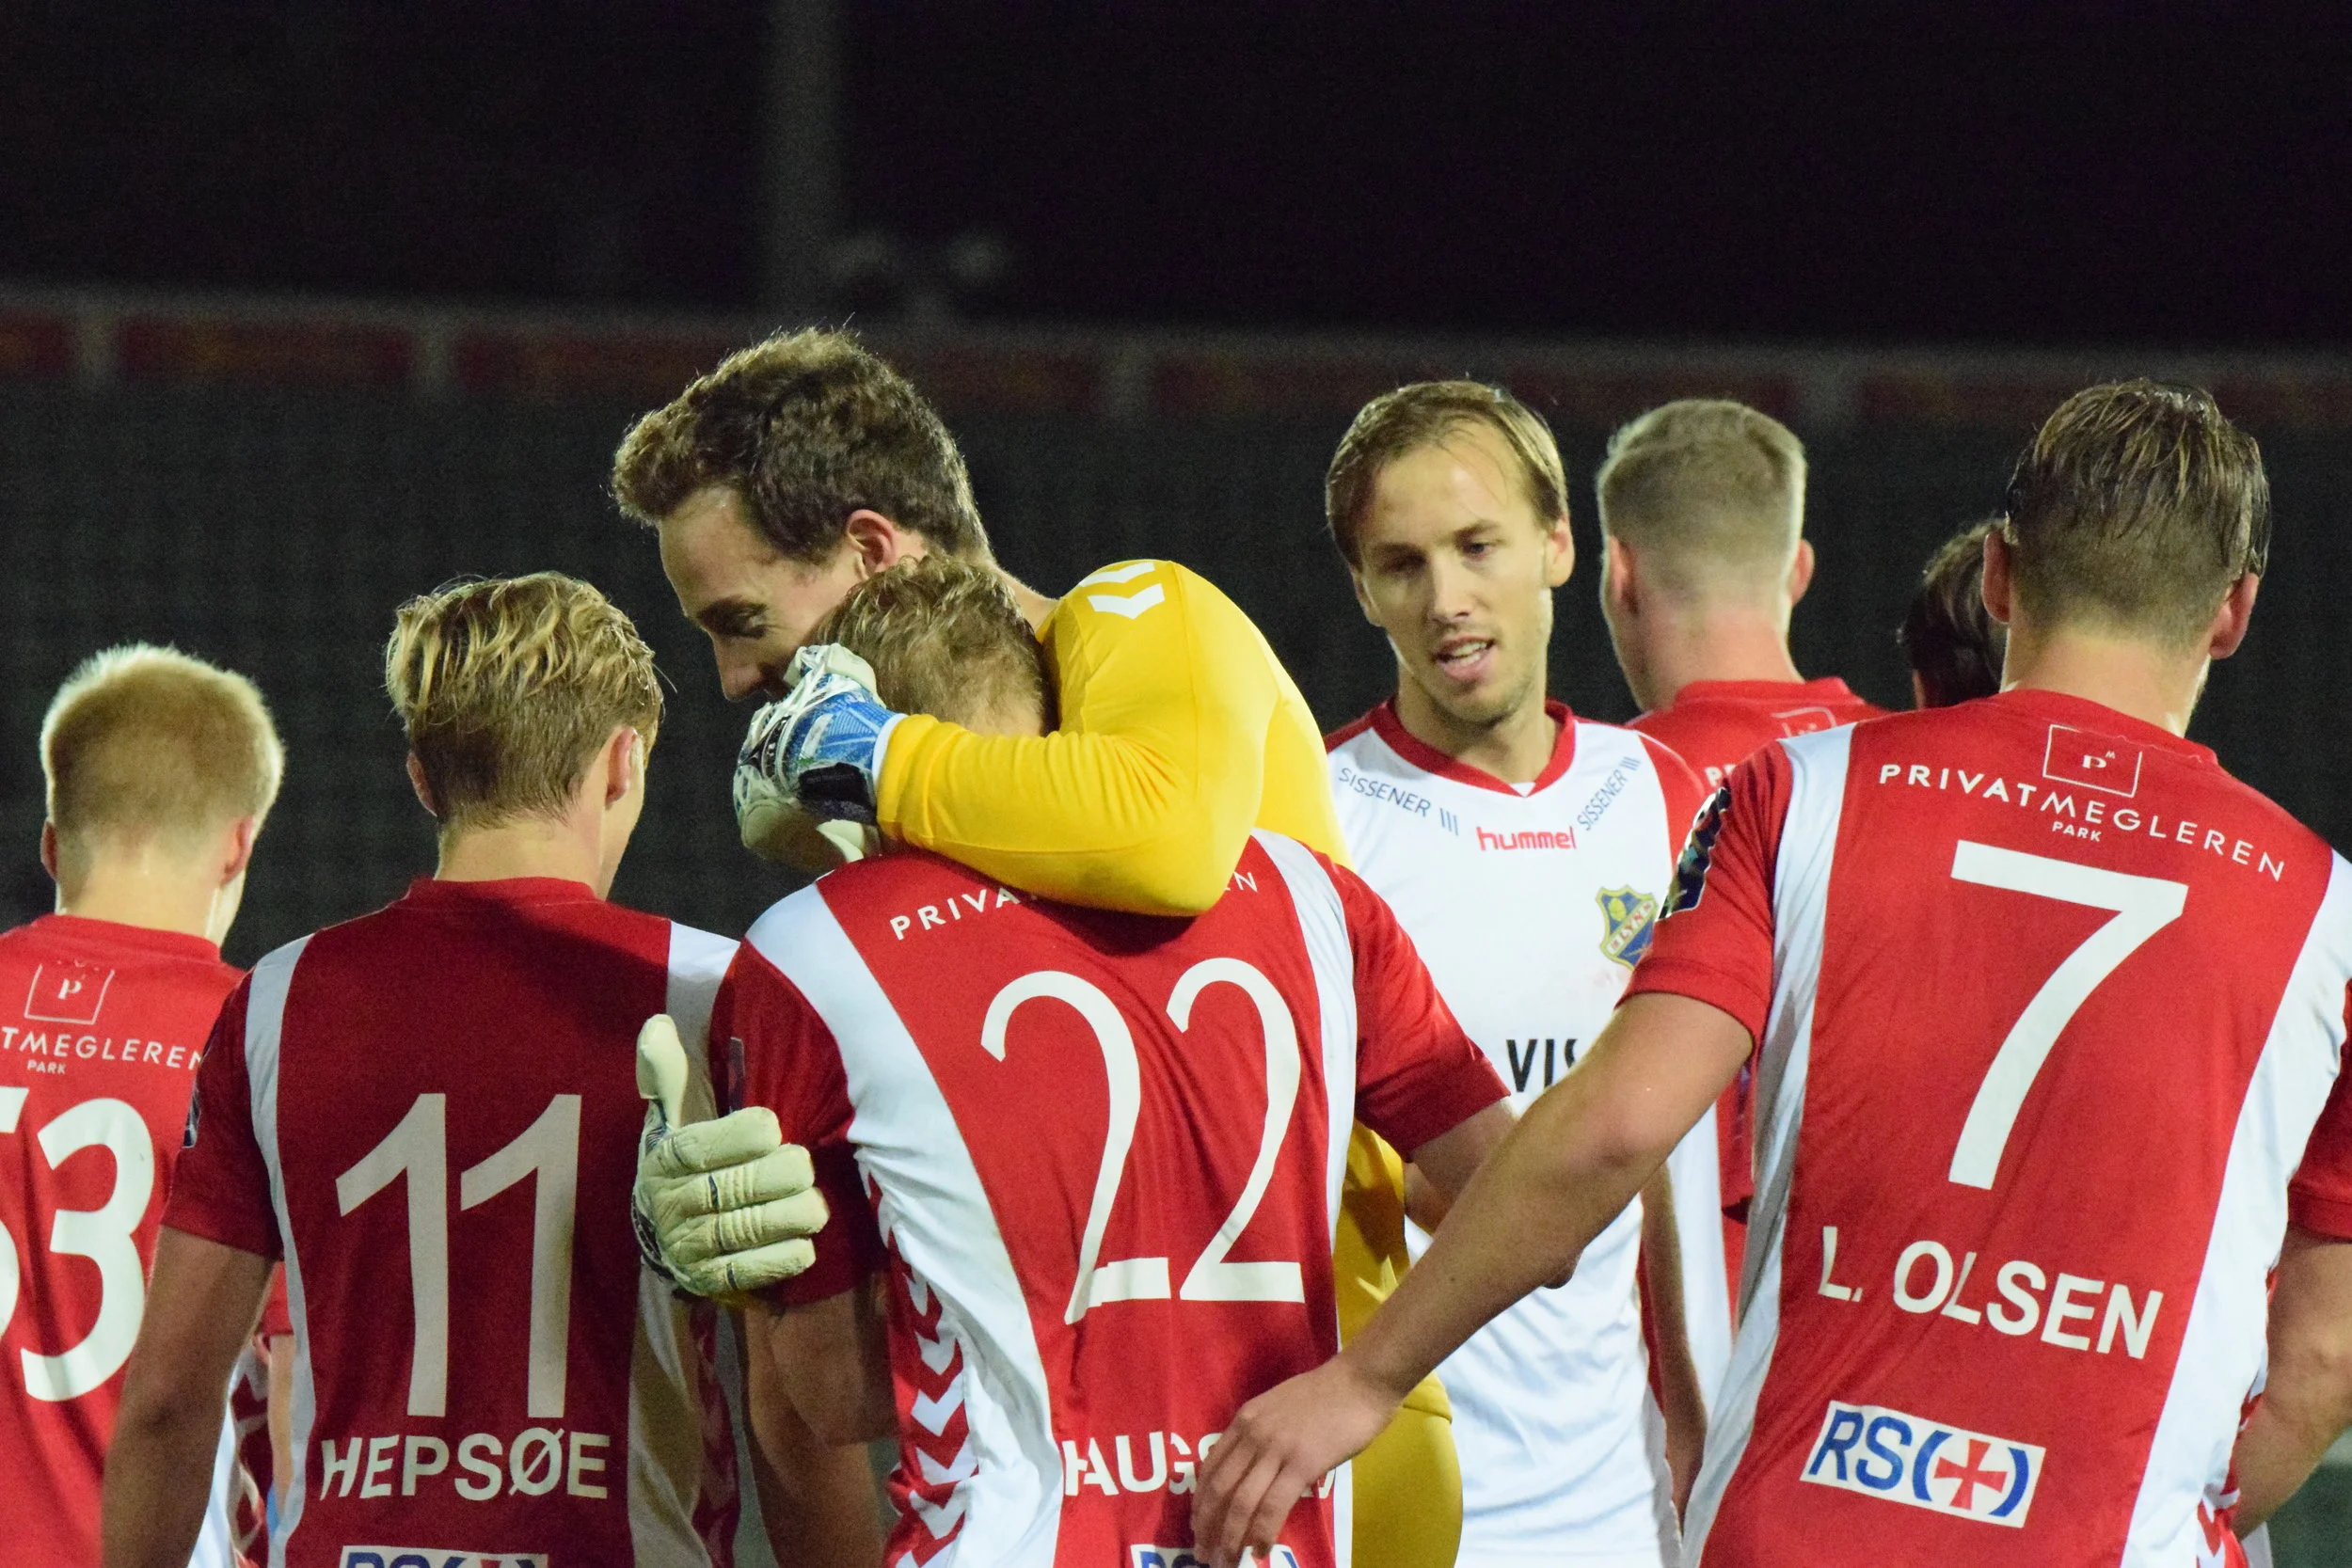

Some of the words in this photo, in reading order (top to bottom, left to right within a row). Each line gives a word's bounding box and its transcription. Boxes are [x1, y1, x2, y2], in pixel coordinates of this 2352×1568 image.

[1339, 768, 1431, 817] SISSENER
[1476, 827, 1576, 851] hummel
[1578, 768, 1629, 831] SISSENER
[1879, 764, 2285, 881] PRIVATMEGLEREN
[2052, 820, 2102, 842] PARK
[1949, 840, 2189, 1190] 7
[27, 1059, 67, 1074] PARK
[981, 958, 1305, 1325] 22
[0, 1086, 155, 1402] 3
[335, 1093, 582, 1418] 11
[1818, 1226, 1864, 1303] L.
[1893, 1241, 2164, 1359] OLSEN
[320, 1428, 611, 1502] HEPSØE
